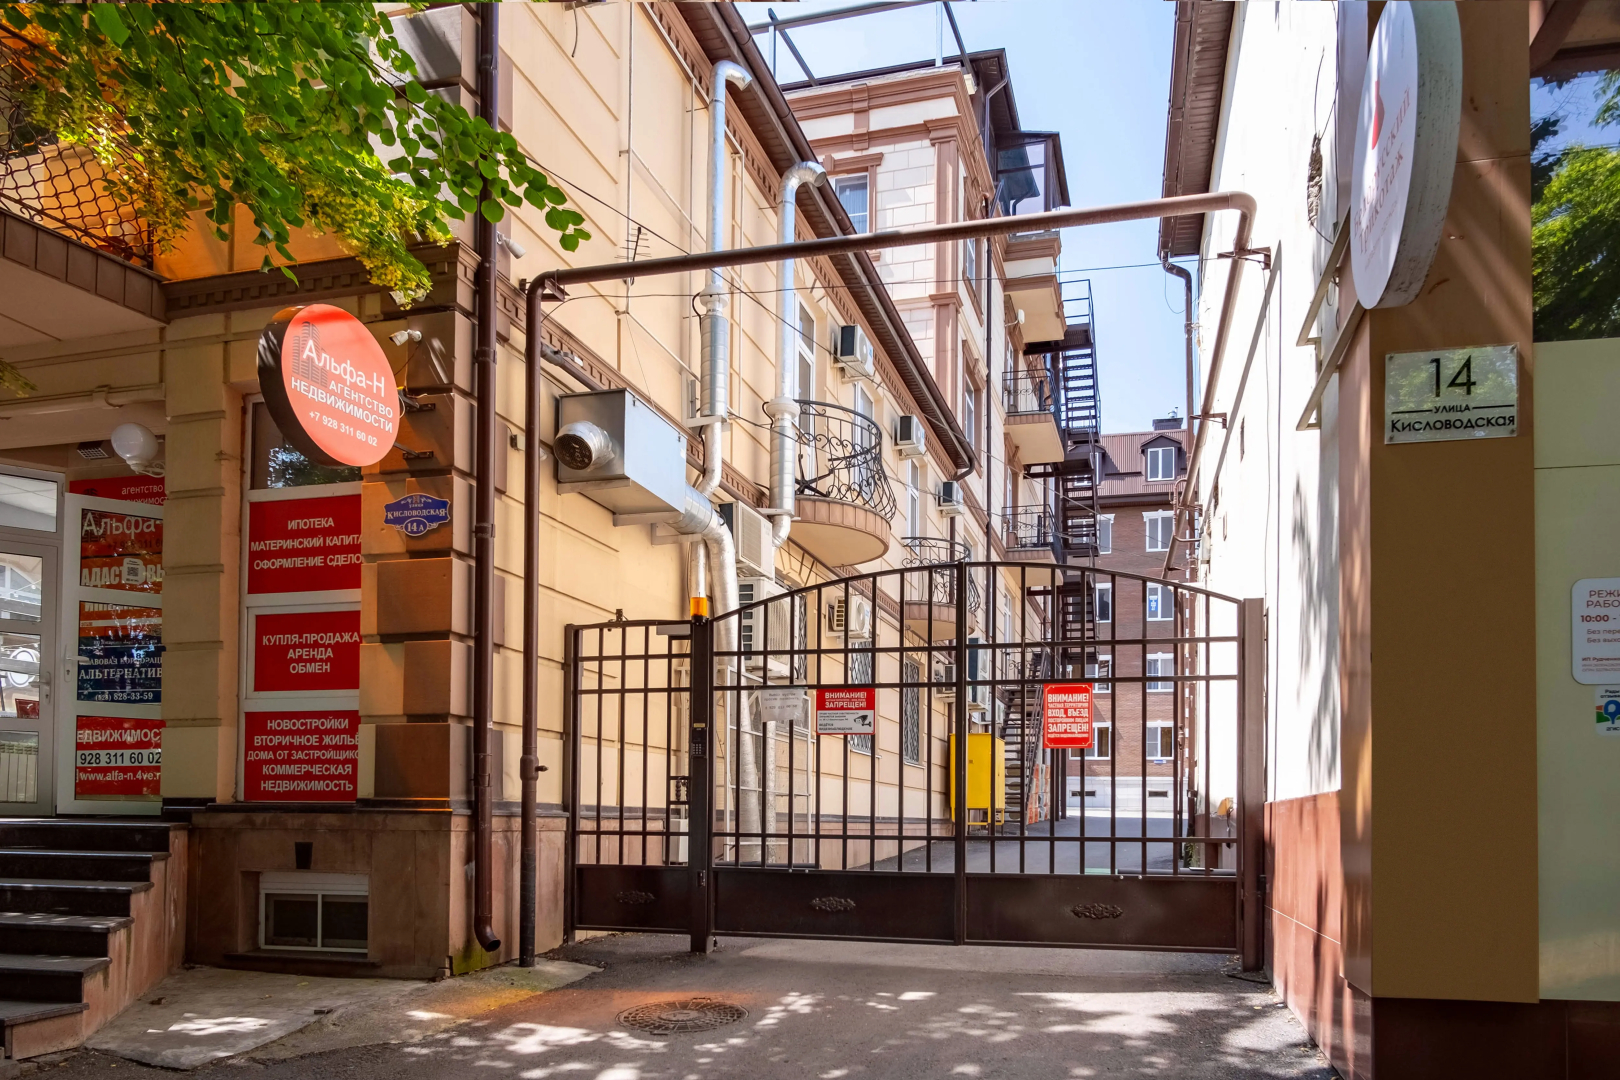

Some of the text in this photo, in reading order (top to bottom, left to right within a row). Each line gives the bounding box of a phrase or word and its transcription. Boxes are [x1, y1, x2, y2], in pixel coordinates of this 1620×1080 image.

[303, 340, 385, 397] Альфа-Н
[1429, 354, 1476, 397] 14
[291, 377, 393, 434] НЕДВИЖИМОСТИ
[329, 380, 393, 418] АГЕНТСТВО
[309, 410, 378, 446] +7 928 311 60 02
[121, 484, 164, 495] агентство
[387, 508, 446, 519] КИСЛОВОДСКАЯ
[287, 517, 335, 530] ИПОТЕКА
[407, 522, 418, 532] 14
[250, 535, 324, 551] МАТЕРИНСКИЙ
[253, 553, 364, 570] ОФОРМЛЕНИЕ СДЕЛО
[1580, 614, 1609, 623] 10:00
[262, 631, 360, 645] КУПЛЯ-ПРОДАЖА
[287, 648, 334, 660] АРЕНДА
[289, 662, 331, 673] ОБМЕН
[113, 692, 153, 701] 828-33-59
[1047, 693, 1089, 702] ВНИМАНИЕ!
[1048, 709, 1089, 717] ВХОД, ВЪЕЗД
[267, 716, 349, 730] НОВОСТРОЙКИ
[77, 728, 161, 745] ЕДВИЖИМОС
[254, 735, 320, 746] ВТОРИЧНОЕ
[80, 752, 161, 765] 928 311 60 02
[247, 751, 275, 761] ДОМА
[276, 751, 289, 759] ОТ
[262, 764, 353, 775] КОММЕРЧЕСКАЯ
[260, 780, 354, 793] НЕДВИЖИМОСТЬ
